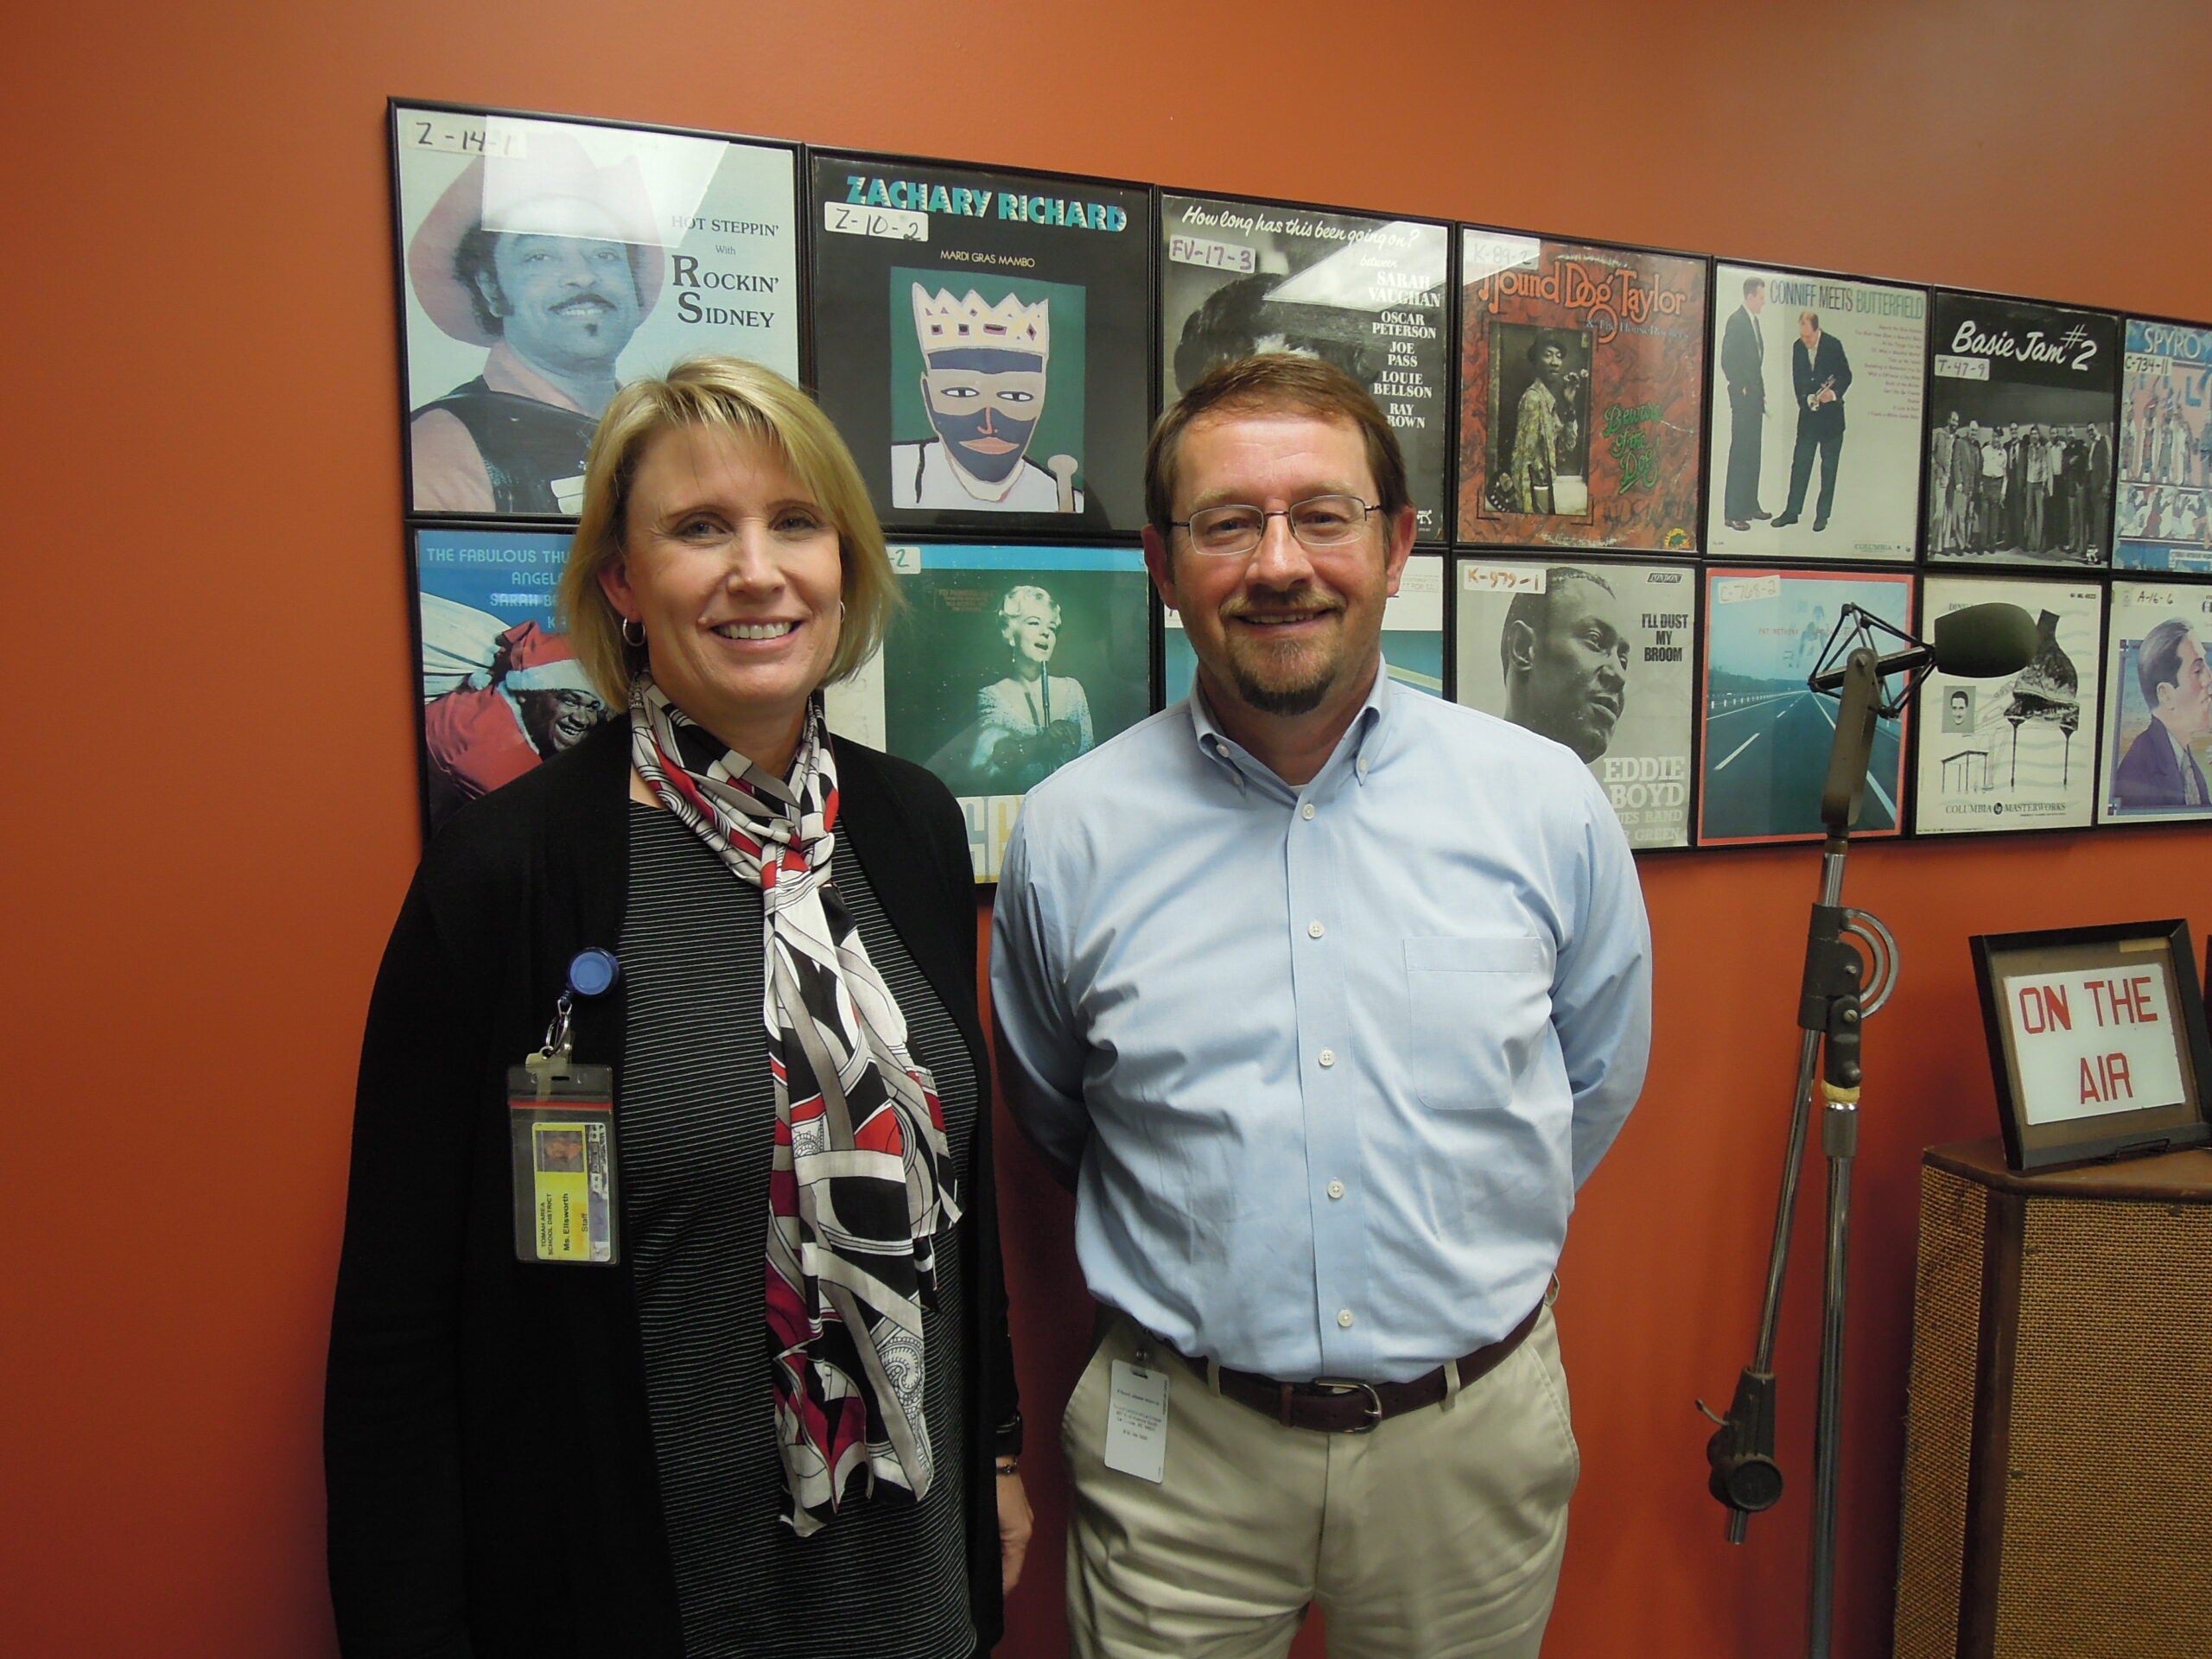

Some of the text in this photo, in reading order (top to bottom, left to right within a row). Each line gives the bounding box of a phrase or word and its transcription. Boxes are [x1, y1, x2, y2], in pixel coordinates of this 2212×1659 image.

[846, 175, 1128, 233] ZACHARY RICHARD
[671, 213, 779, 238] HOT STEPPIN'
[1181, 204, 1421, 251] How long has this been going on?
[715, 243, 737, 257] With
[939, 249, 1036, 269] MARDI GRAS MAMBO
[1171, 238, 1255, 272] FV-17-3
[671, 254, 779, 294] ROCKIN'
[1376, 270, 1431, 290] SARAH
[1368, 286, 1441, 308] VAUGHAN
[1564, 261, 1620, 345] Dog
[1614, 268, 1688, 324] Taylor
[1770, 279, 1924, 321] CONNIFF MEETS BUTTERFIELD
[677, 291, 775, 329] SIDNEY
[1381, 310, 1426, 327] OSCAR
[1371, 322, 1437, 340] PETERSON
[1389, 340, 1415, 355] JOE
[1951, 320, 2015, 359] Basie
[2015, 330, 2066, 365] Jam
[2144, 326, 2202, 359] SPYRO
[1387, 353, 1419, 368] PASS
[1382, 370, 1423, 385] LOUIE
[1373, 383, 1433, 400] BELLSON
[1389, 403, 1414, 416] RAY
[1386, 414, 1426, 429] ROWN
[1604, 402, 1663, 438] Beware
[1610, 426, 1630, 459] of
[426, 548, 454, 562] THE
[459, 548, 537, 563] FABULOUS
[490, 593, 539, 607] SARAH
[1642, 613, 1688, 629] I'LL DUST
[1656, 630, 1673, 645] MY
[1643, 646, 1683, 663] BROOM
[1603, 755, 1687, 783] EDDIE
[1609, 781, 1685, 809] BOYD
[1643, 809, 1684, 824] BAND
[1945, 802, 2066, 814] COLUMBIA MASTERWORKS
[1634, 826, 1681, 842] GREEN
[2018, 976, 2158, 1035] ON THE
[2080, 1052, 2134, 1105] AIR
[562, 1192, 570, 1235] Ellsworth
